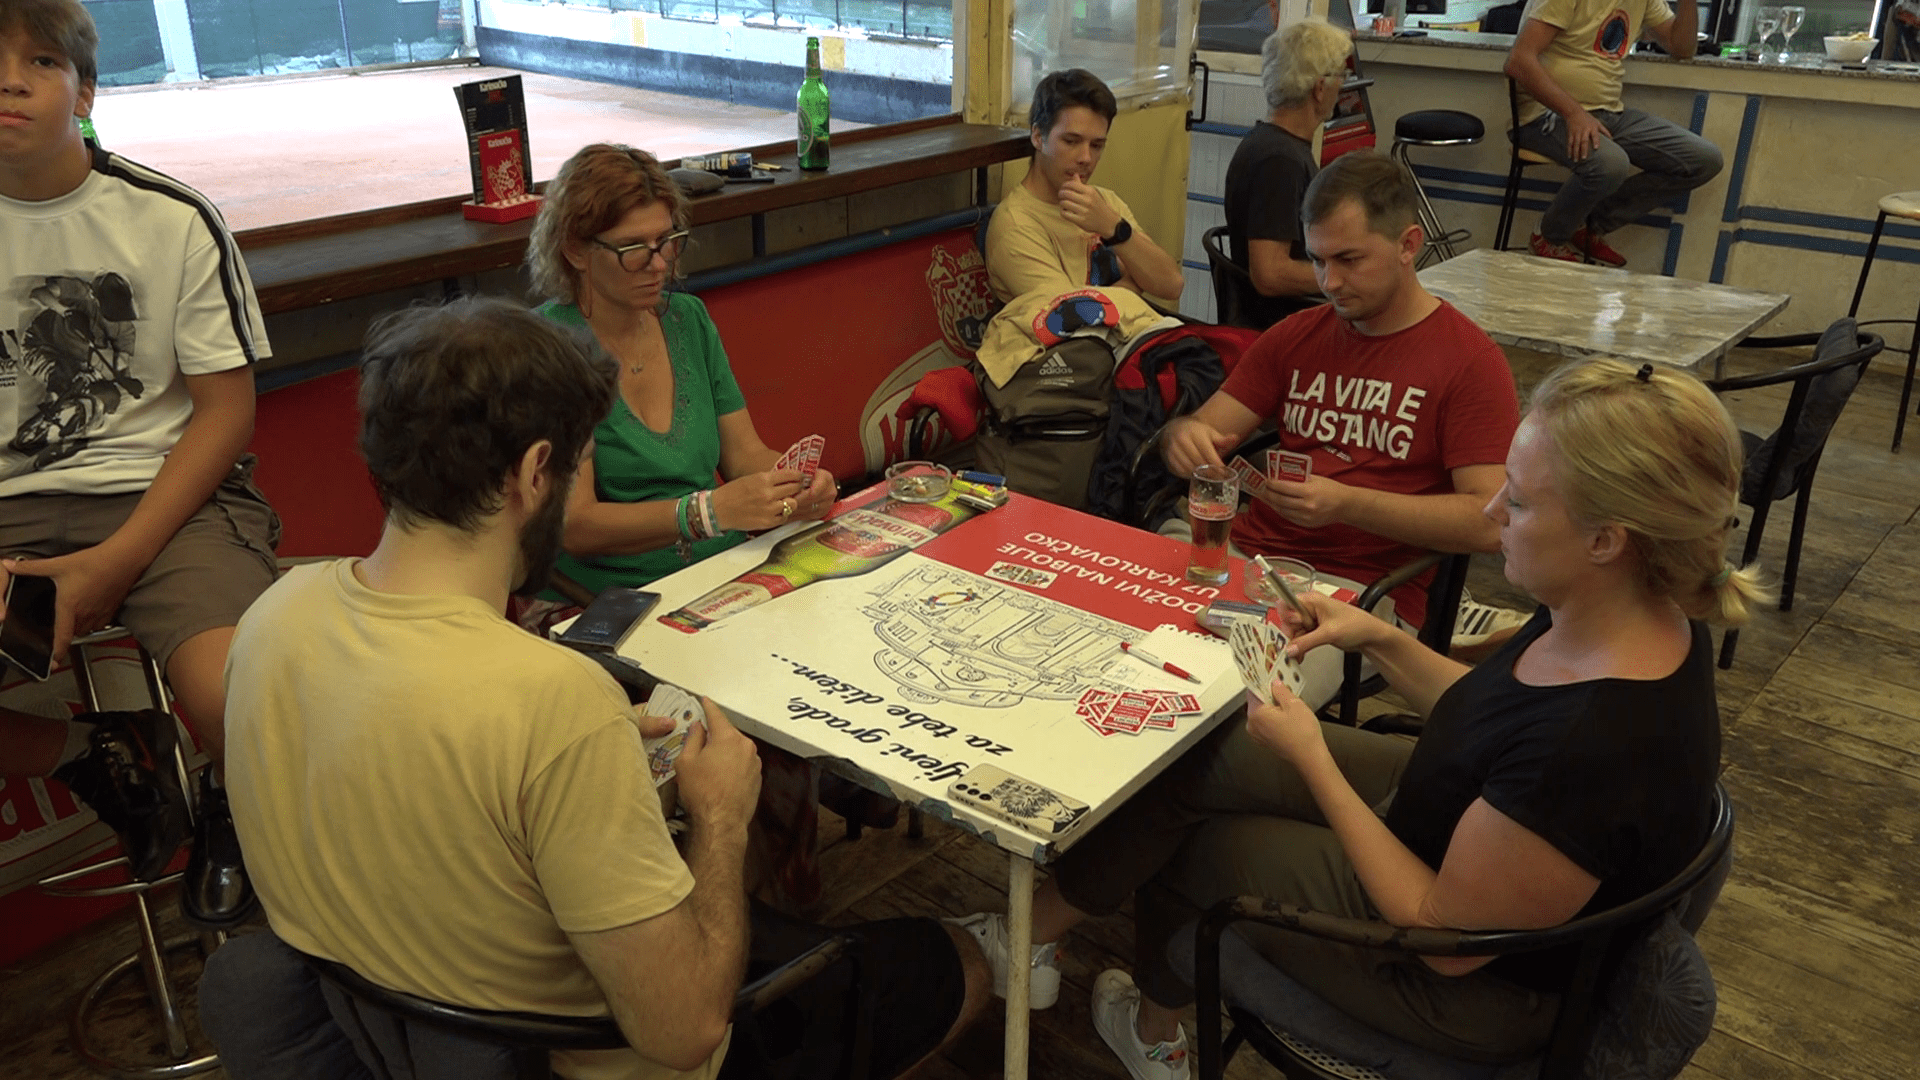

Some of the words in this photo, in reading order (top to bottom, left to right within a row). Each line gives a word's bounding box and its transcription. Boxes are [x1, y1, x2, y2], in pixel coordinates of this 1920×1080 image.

[1039, 366, 1073, 376] adidas
[1288, 369, 1326, 403] LA
[1335, 374, 1392, 415] VITA
[1396, 386, 1427, 423] E
[1283, 402, 1414, 460] MUSTANG
[996, 542, 1114, 586] NAJBOLJE
[1024, 532, 1180, 587] KARLOVAČKO
[1113, 578, 1205, 614] DOŽIVI
[786, 697, 890, 748] grade,
[887, 705, 957, 739] tebe
[879, 743, 969, 782] ljeni
[964, 734, 1014, 757] za
